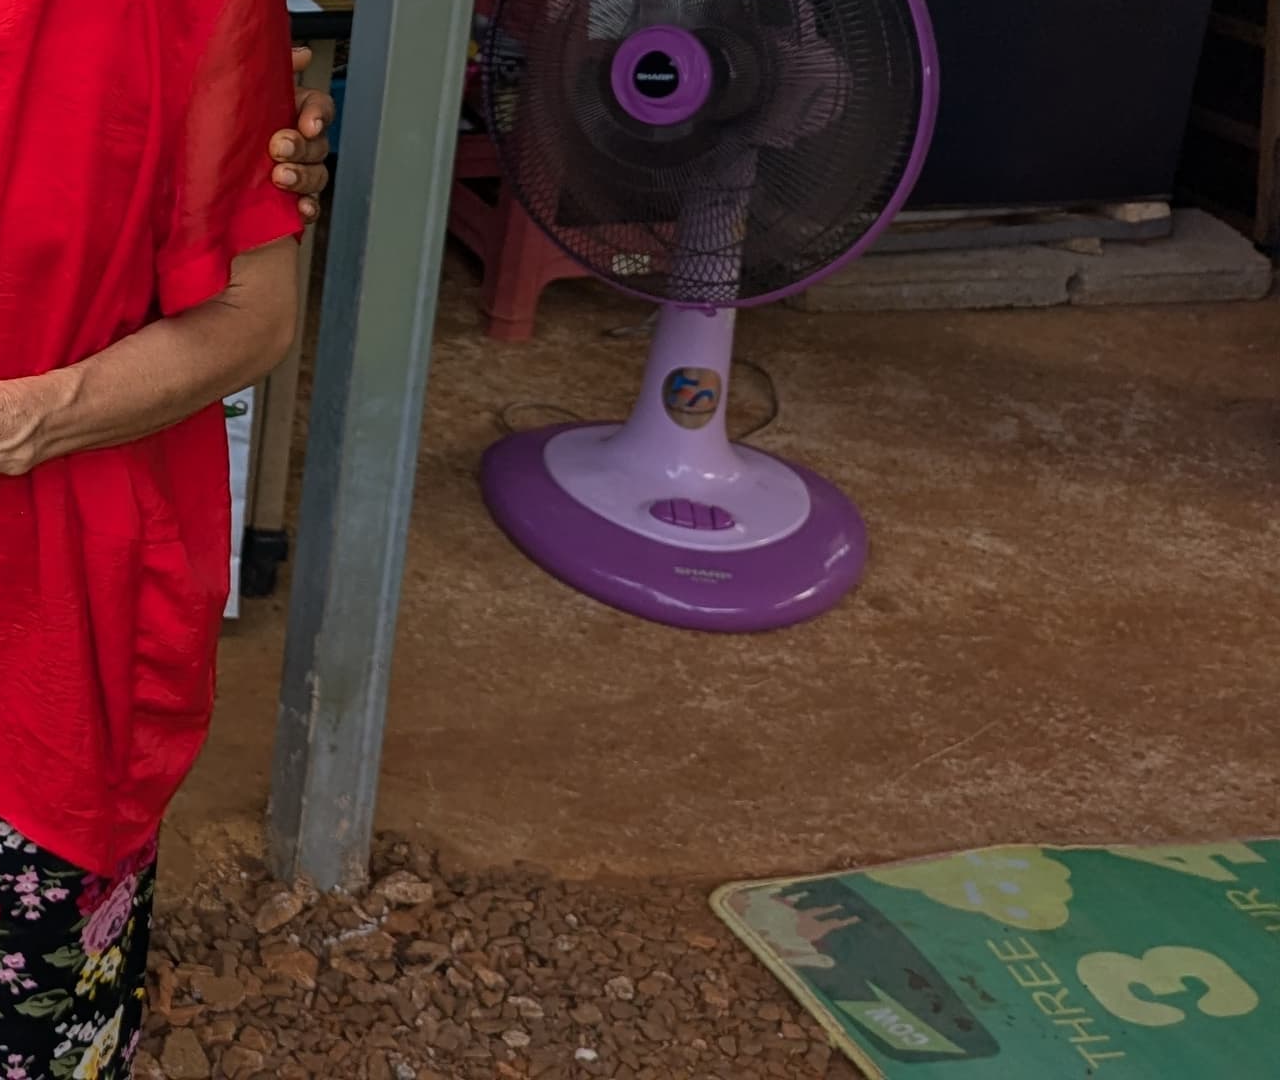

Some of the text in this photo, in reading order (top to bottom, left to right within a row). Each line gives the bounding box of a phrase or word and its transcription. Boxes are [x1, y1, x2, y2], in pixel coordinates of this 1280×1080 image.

[864, 1005, 930, 1047] COW
[986, 935, 1128, 1070] THREE
[1076, 945, 1260, 1028] 3
